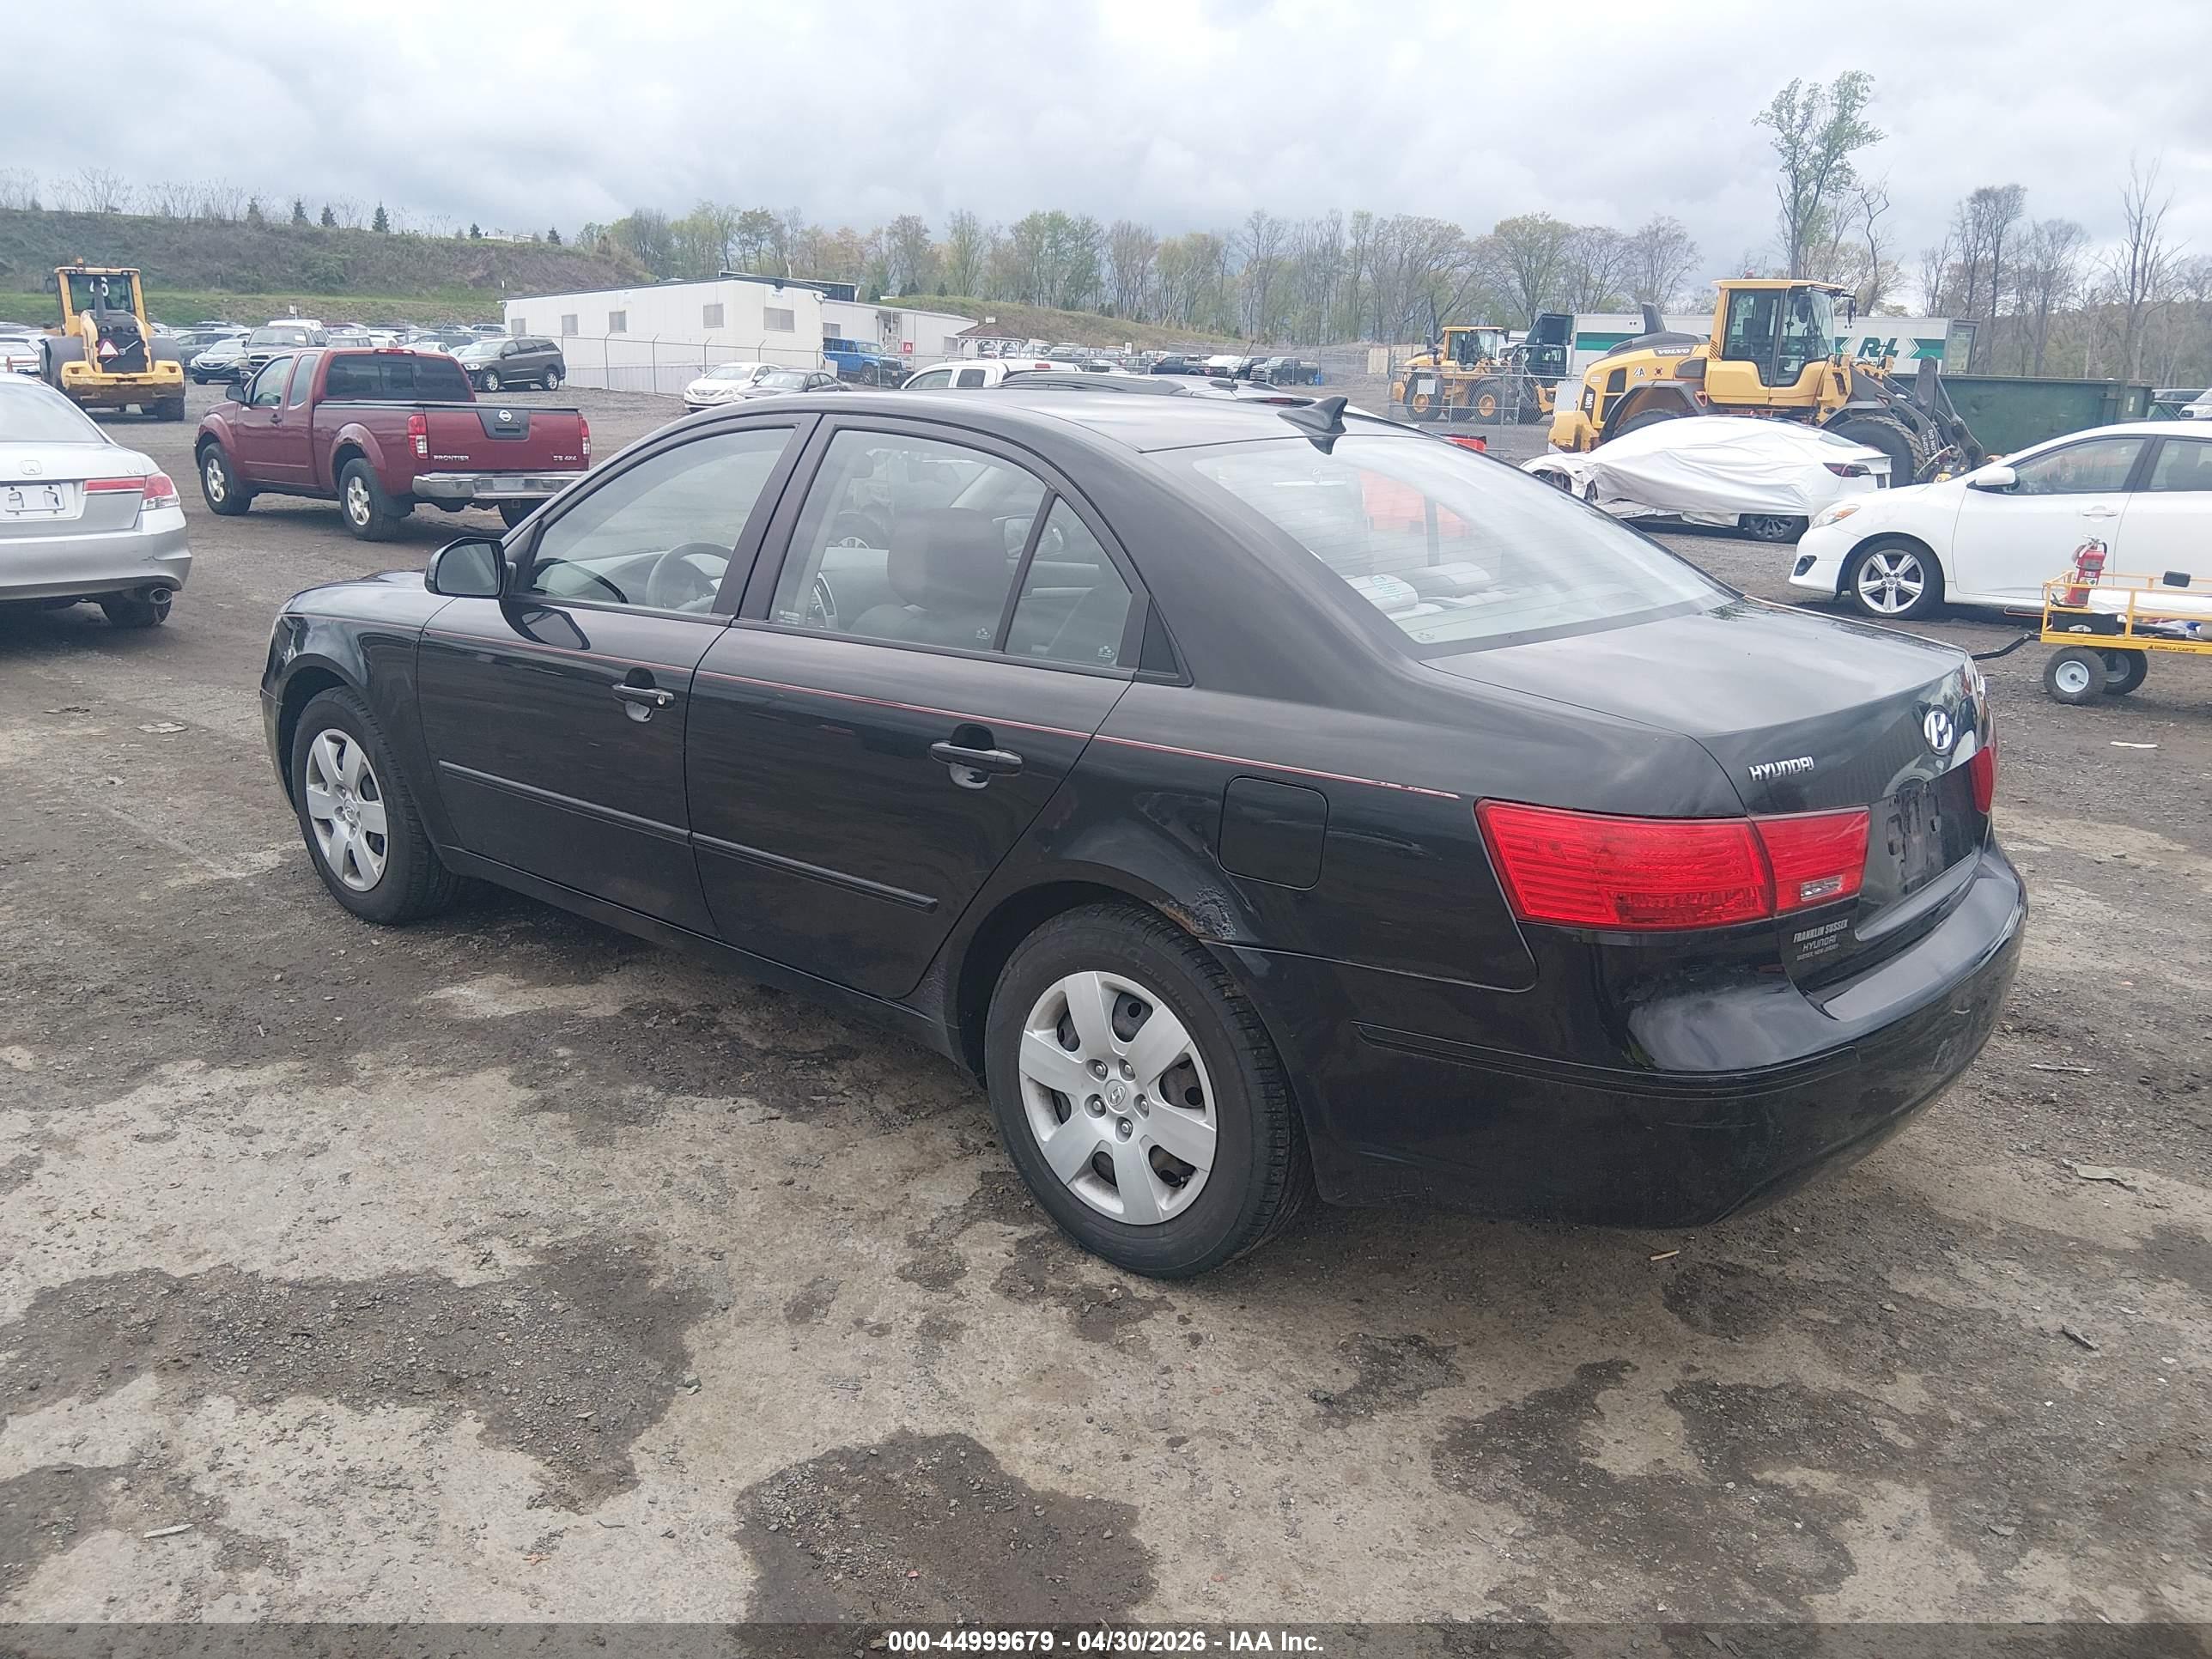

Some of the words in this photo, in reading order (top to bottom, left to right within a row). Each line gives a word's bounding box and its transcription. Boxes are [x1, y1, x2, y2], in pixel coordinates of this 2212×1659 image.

[1928, 429, 1935, 440] DO
[1748, 756, 1814, 781] HYUNDAI
[1793, 927, 1825, 943] FRANKLIN
[1825, 919, 1848, 934] SUSSEX
[1802, 934, 1837, 952] HYUNDAI
